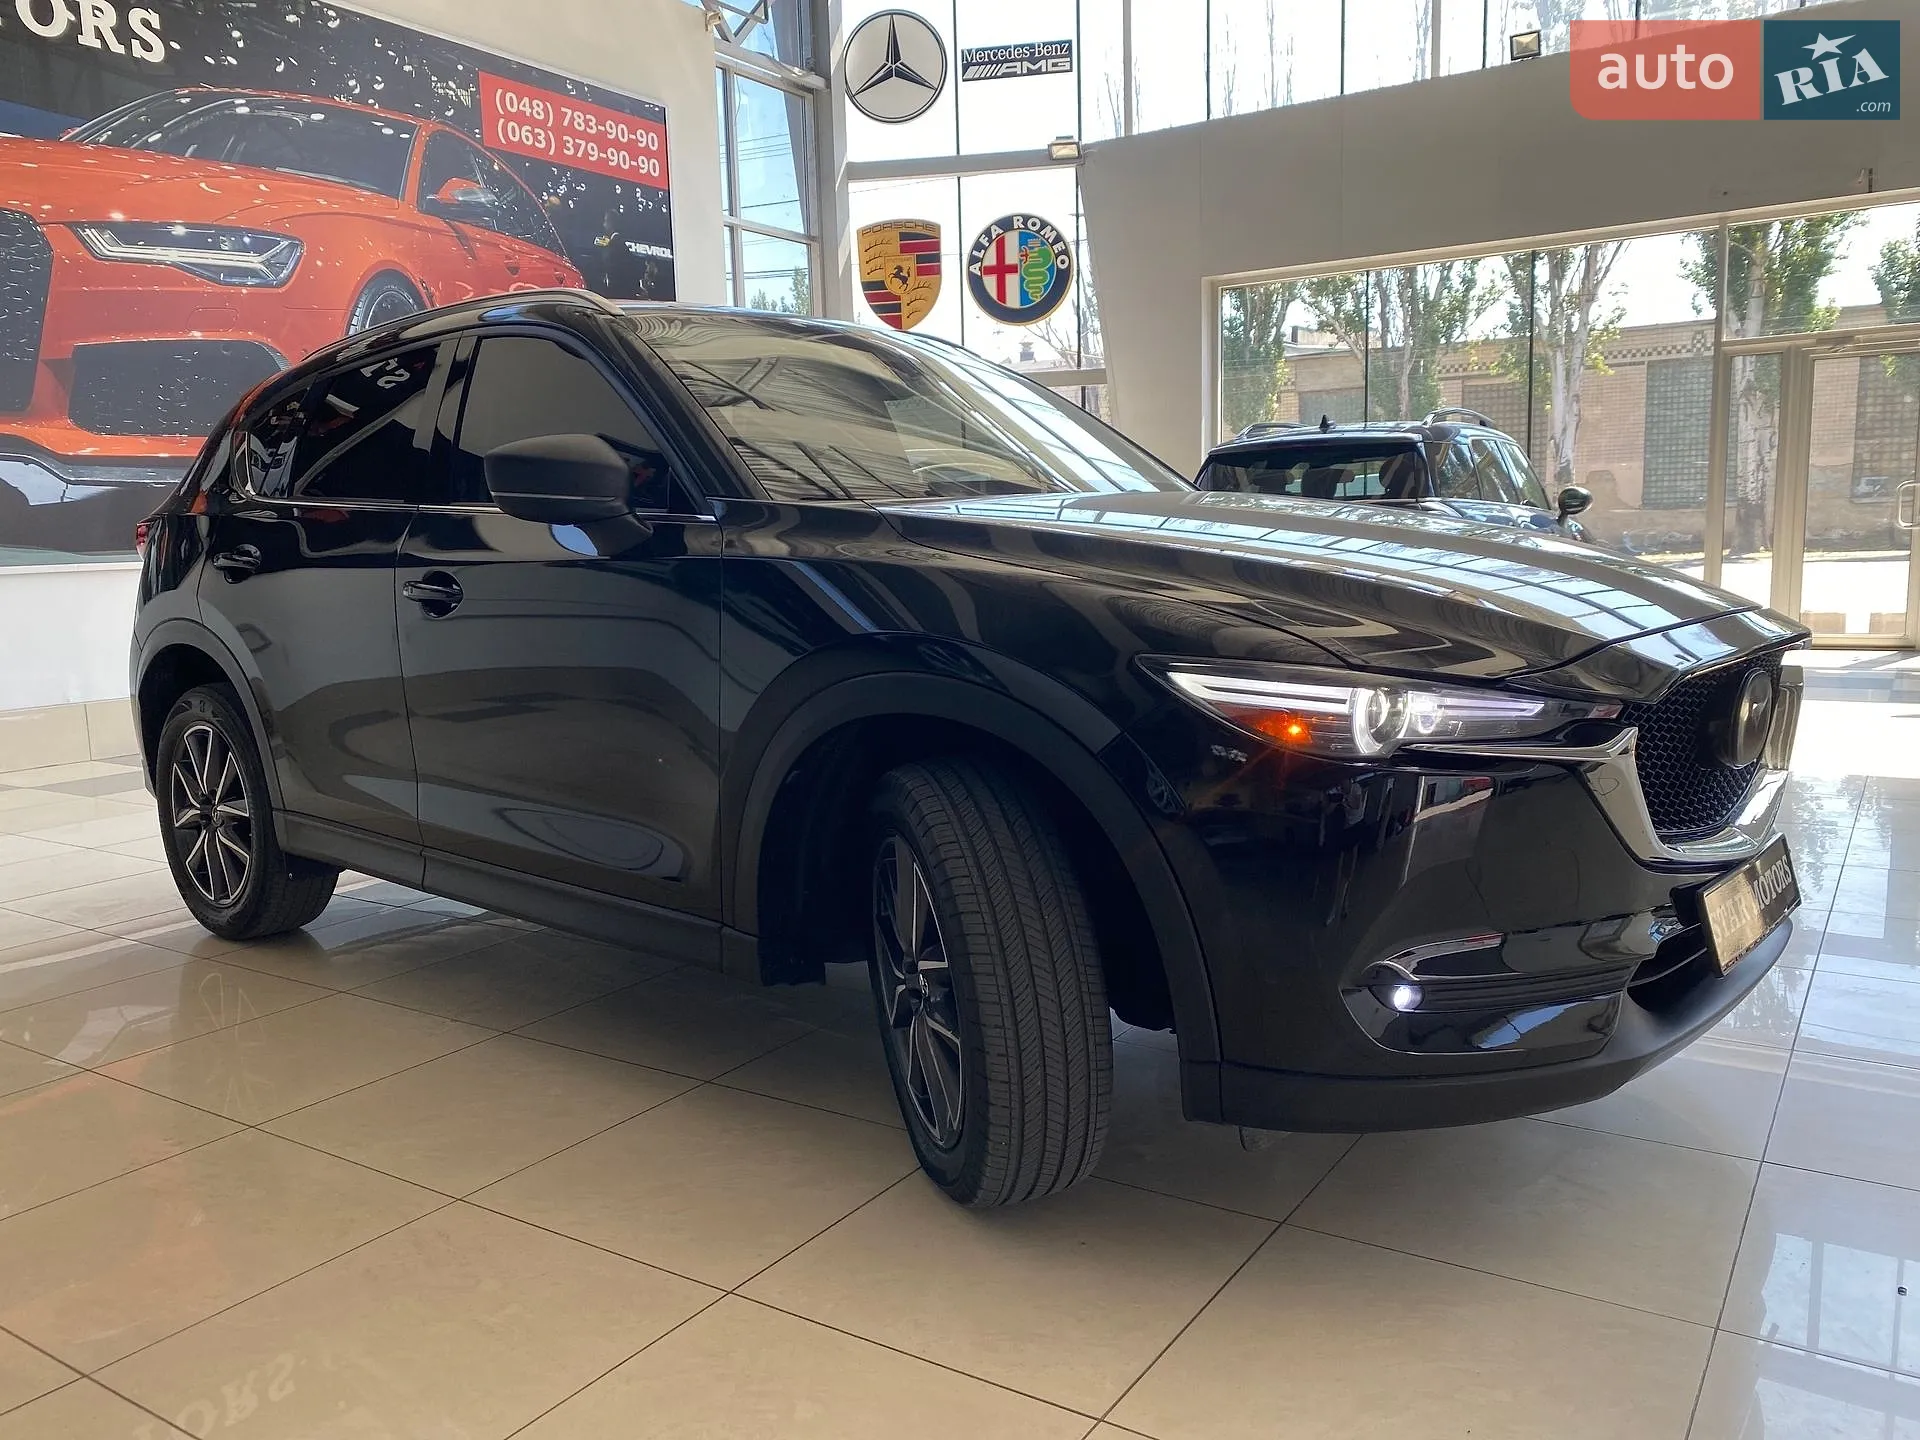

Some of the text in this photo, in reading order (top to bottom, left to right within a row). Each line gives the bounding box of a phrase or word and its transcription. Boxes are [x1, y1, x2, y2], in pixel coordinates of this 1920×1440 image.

[963, 42, 1069, 64] Mercedes-Benz
[495, 88, 660, 151] (048) 783-90-90
[497, 118, 660, 178] (063) 379-90-90
[862, 221, 936, 236] PORSCHE
[969, 215, 1071, 275] ALFA ROMEO
